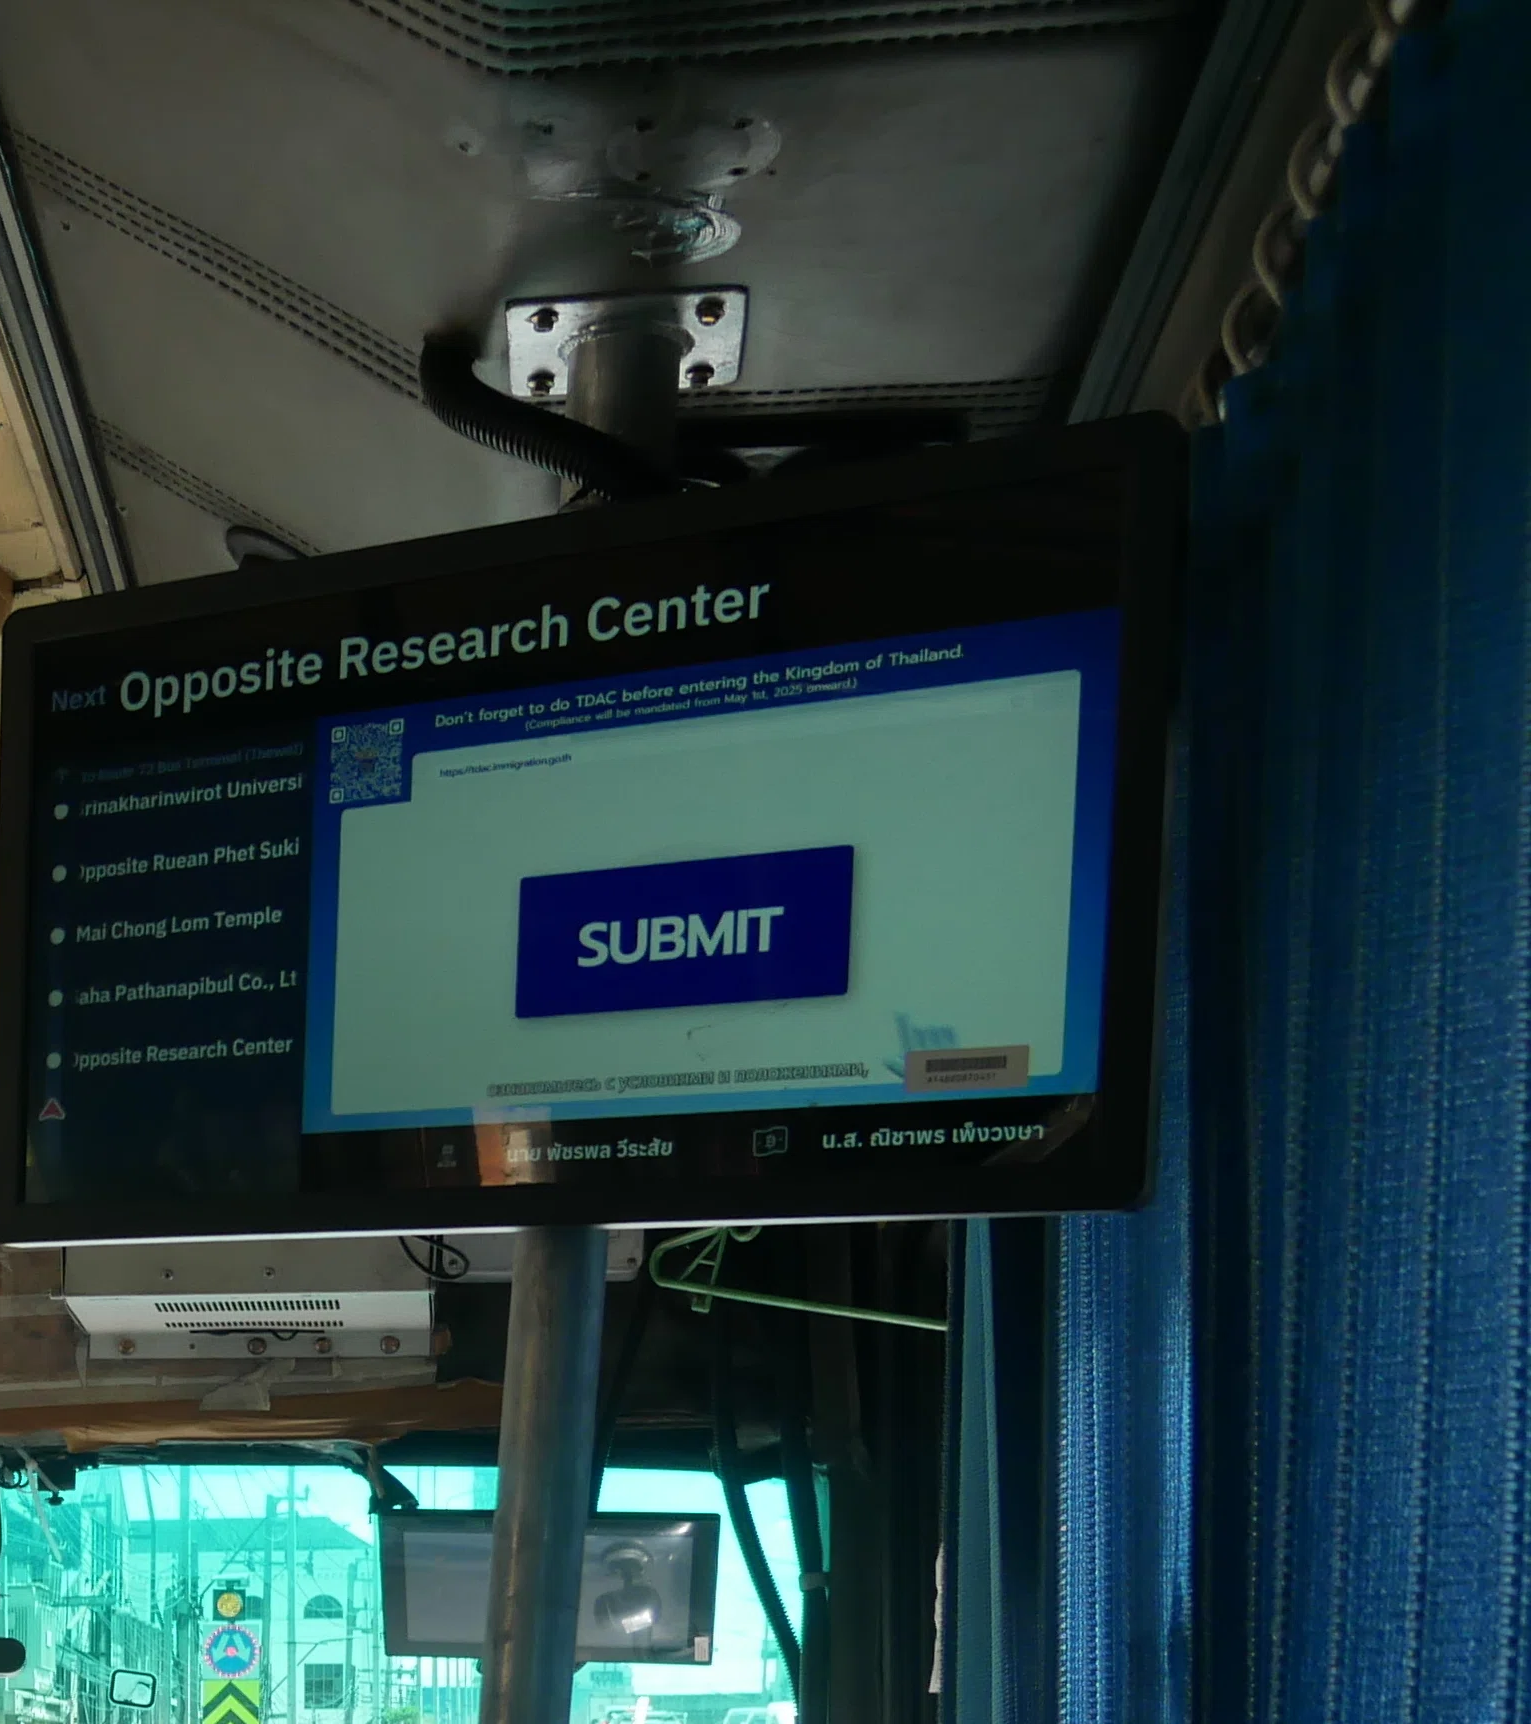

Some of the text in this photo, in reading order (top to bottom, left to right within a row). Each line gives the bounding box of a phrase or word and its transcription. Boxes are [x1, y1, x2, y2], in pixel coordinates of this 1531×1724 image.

[51, 582, 770, 719] Next Opposite Research Center
[435, 643, 964, 729] Don't forget to do TDAC before entering the Kingdom of Thailand.
[525, 713, 591, 731] (Compliance
[595, 709, 612, 720] will
[616, 708, 631, 718] be
[635, 699, 690, 716] mandated
[694, 696, 721, 708] from
[724, 692, 747, 708] May
[773, 684, 803, 699] 2025
[80, 772, 303, 818] rinakharinwirot Universi
[153, 851, 209, 872] Ruean
[213, 843, 256, 865] Phet
[259, 837, 300, 858] Suki
[76, 906, 282, 943] Mai Chong Lom Temple
[576, 905, 785, 970] SUBMIT
[76, 988, 110, 1006] aha
[115, 974, 234, 1003] Pathanapibul
[239, 972, 274, 992] Co.,
[146, 1039, 227, 1063] Research
[232, 1036, 293, 1059] Center
[821, 1131, 863, 1150] น.ส.
[869, 1124, 945, 1147] ณิชาพร
